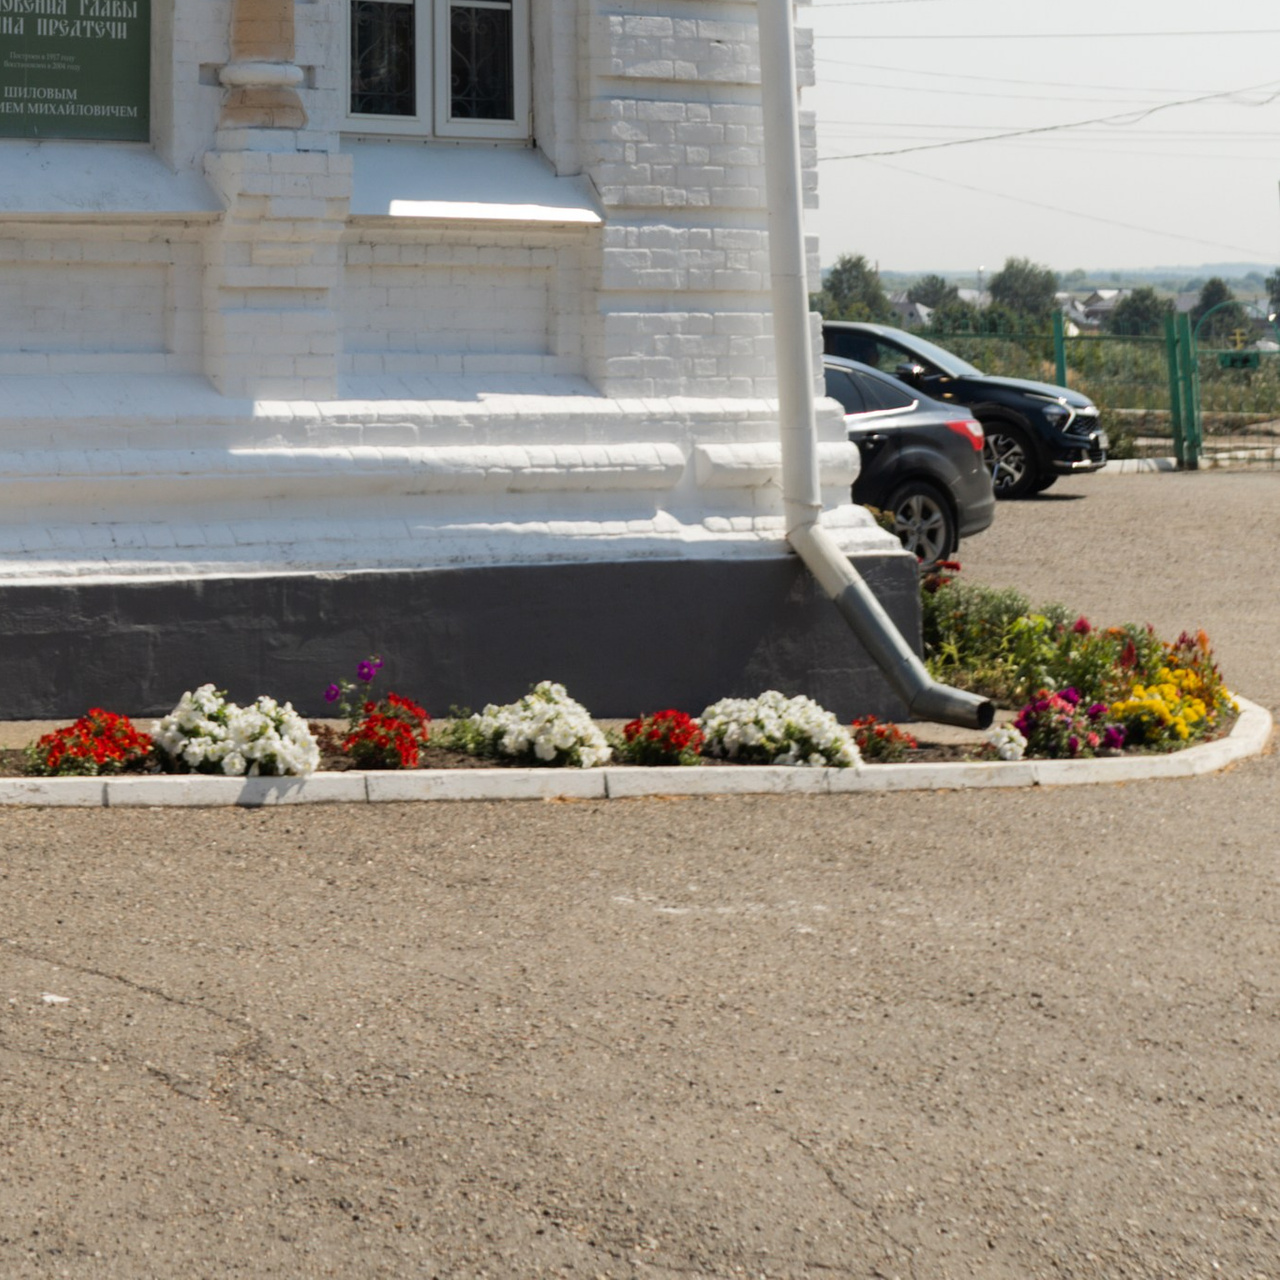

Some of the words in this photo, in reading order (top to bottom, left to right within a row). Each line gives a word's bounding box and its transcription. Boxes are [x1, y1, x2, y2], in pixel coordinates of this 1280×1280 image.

[37, 18, 127, 40] ПРЕДТЕЧИ
[4, 86, 77, 100] ШИЛОВЫМ
[28, 101, 138, 117] МИХАЙЛОВИЧЕМ
